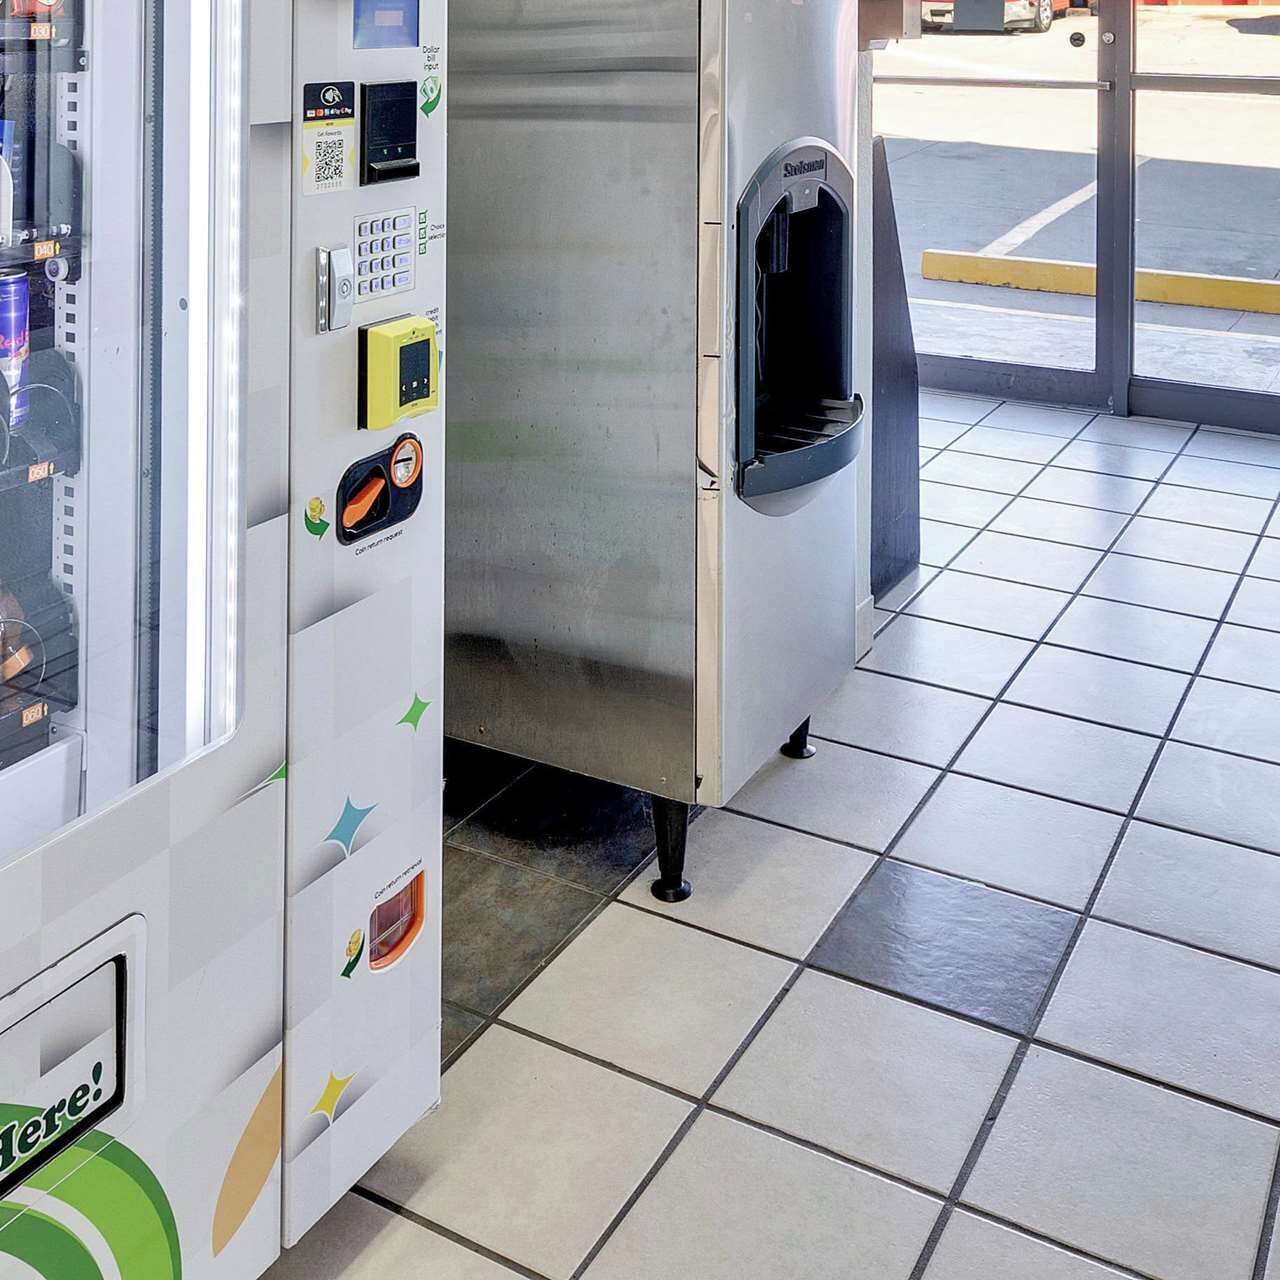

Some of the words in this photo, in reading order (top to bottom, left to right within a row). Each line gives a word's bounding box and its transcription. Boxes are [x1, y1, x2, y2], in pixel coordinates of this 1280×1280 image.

[426, 54, 436, 62] bill
[424, 63, 439, 72] input
[355, 546, 366, 556] Coin
[22, 707, 43, 725] 060
